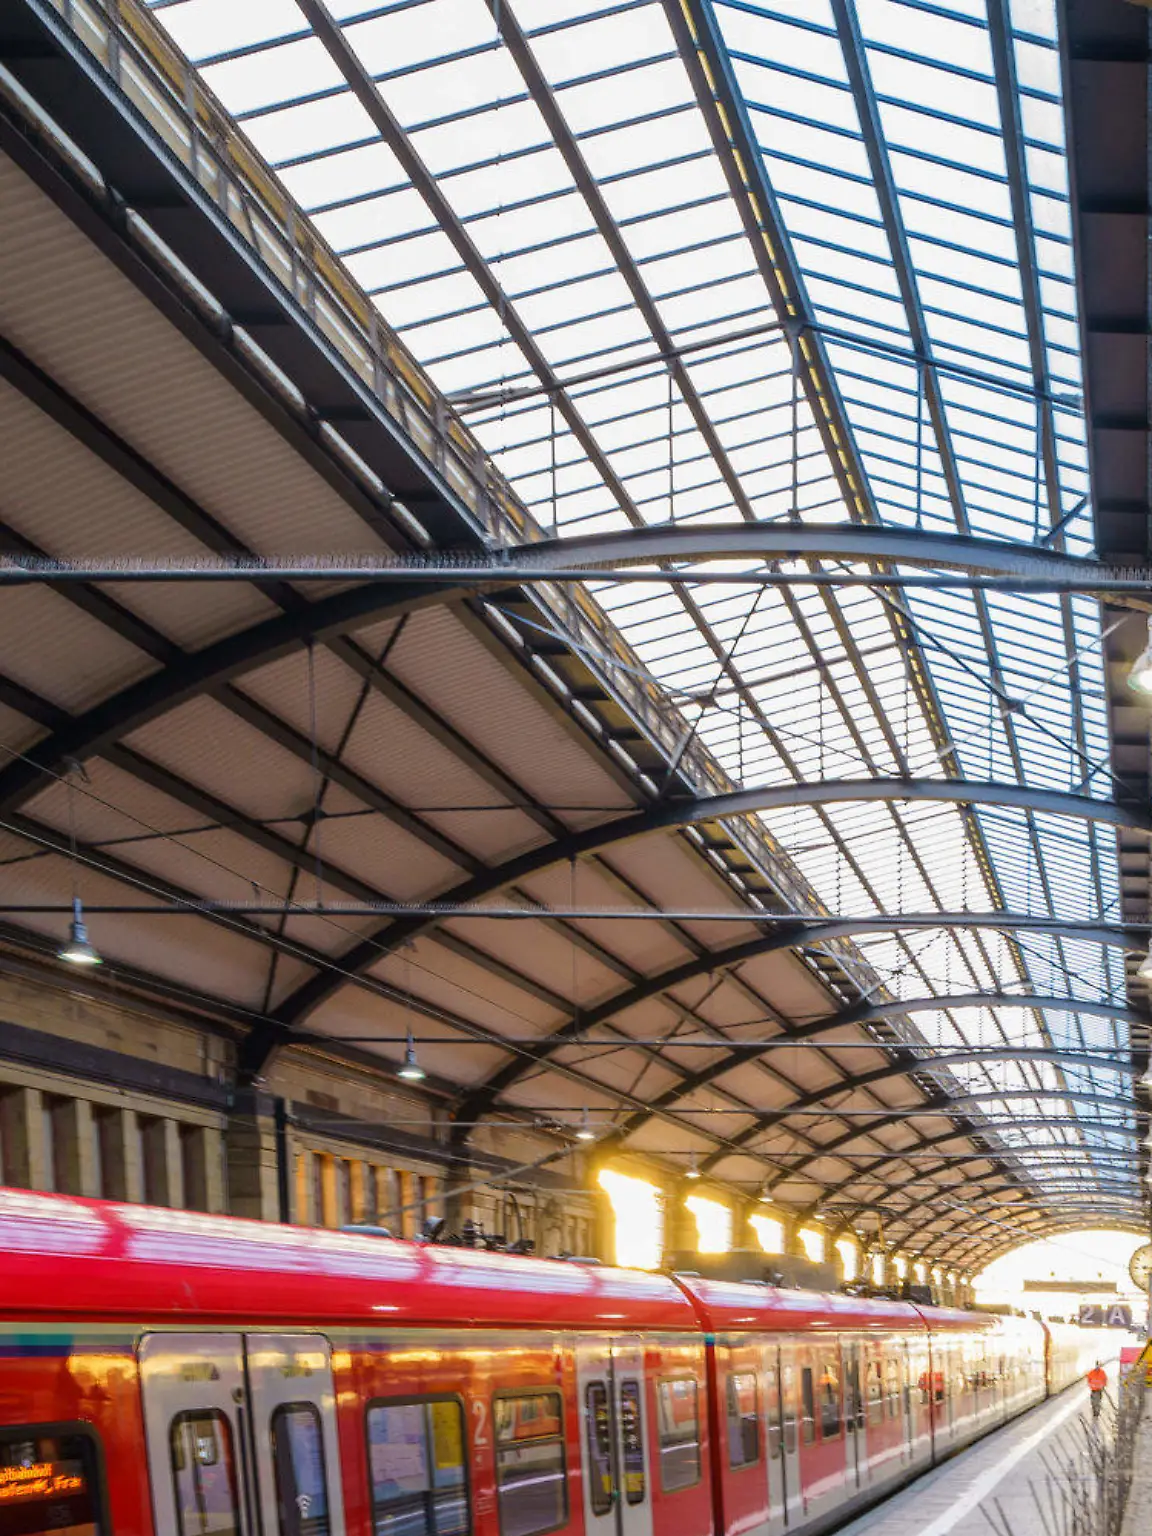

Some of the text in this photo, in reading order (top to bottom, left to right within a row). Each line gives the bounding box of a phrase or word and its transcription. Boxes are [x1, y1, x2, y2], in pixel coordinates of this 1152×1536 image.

[1080, 1304, 1126, 1325] 2 A
[472, 1401, 488, 1445] 2
